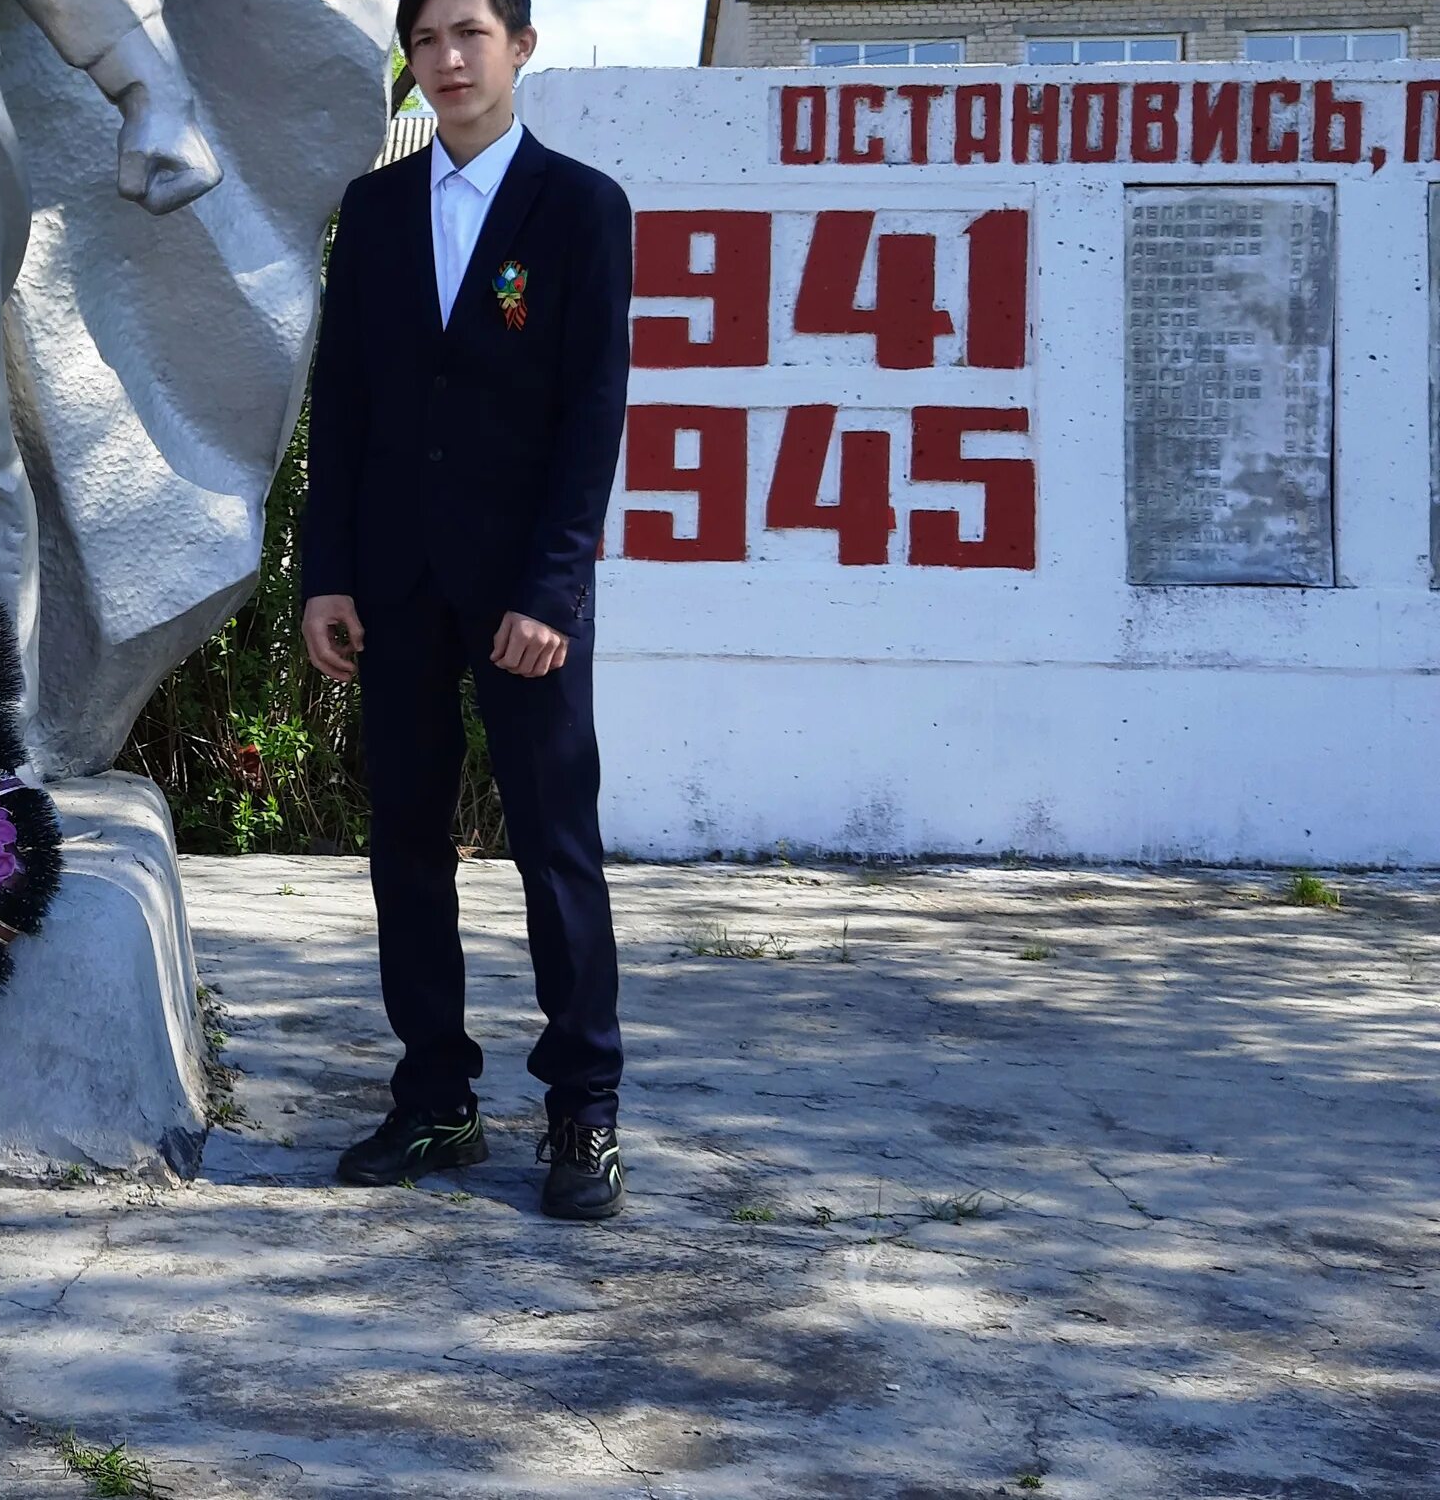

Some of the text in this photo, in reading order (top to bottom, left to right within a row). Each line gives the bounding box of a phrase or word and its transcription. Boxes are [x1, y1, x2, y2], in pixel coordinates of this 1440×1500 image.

[780, 80, 1387, 174] ОСТАНОВИСЬ,
[630, 209, 1029, 369] 941
[596, 403, 1036, 569] 945
